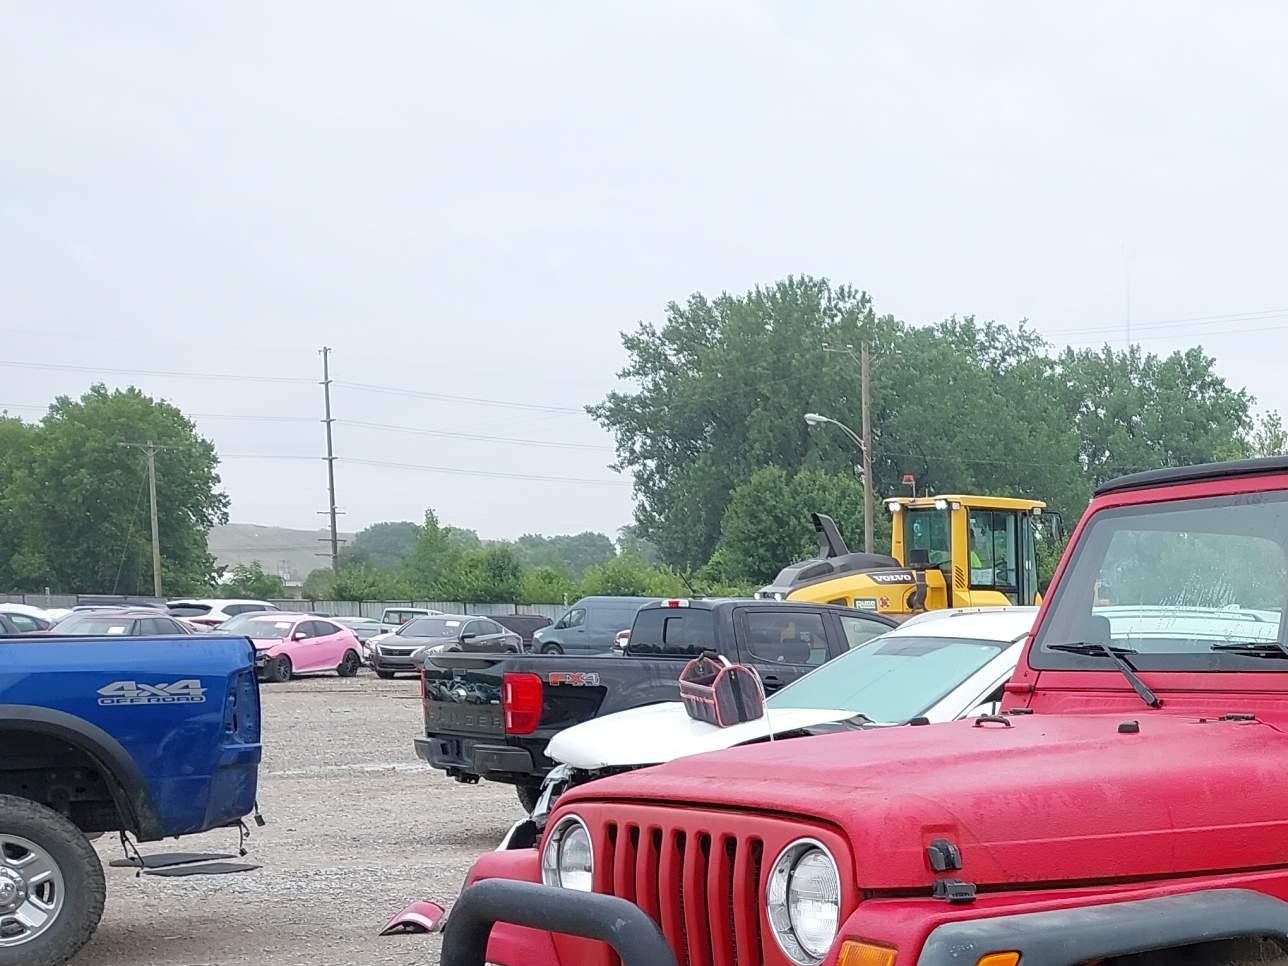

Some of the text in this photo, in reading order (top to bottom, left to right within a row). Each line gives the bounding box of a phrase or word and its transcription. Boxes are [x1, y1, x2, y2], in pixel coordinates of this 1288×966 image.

[872, 574, 912, 582] VOLVO
[549, 672, 600, 687] FX4
[100, 697, 142, 705] OFF
